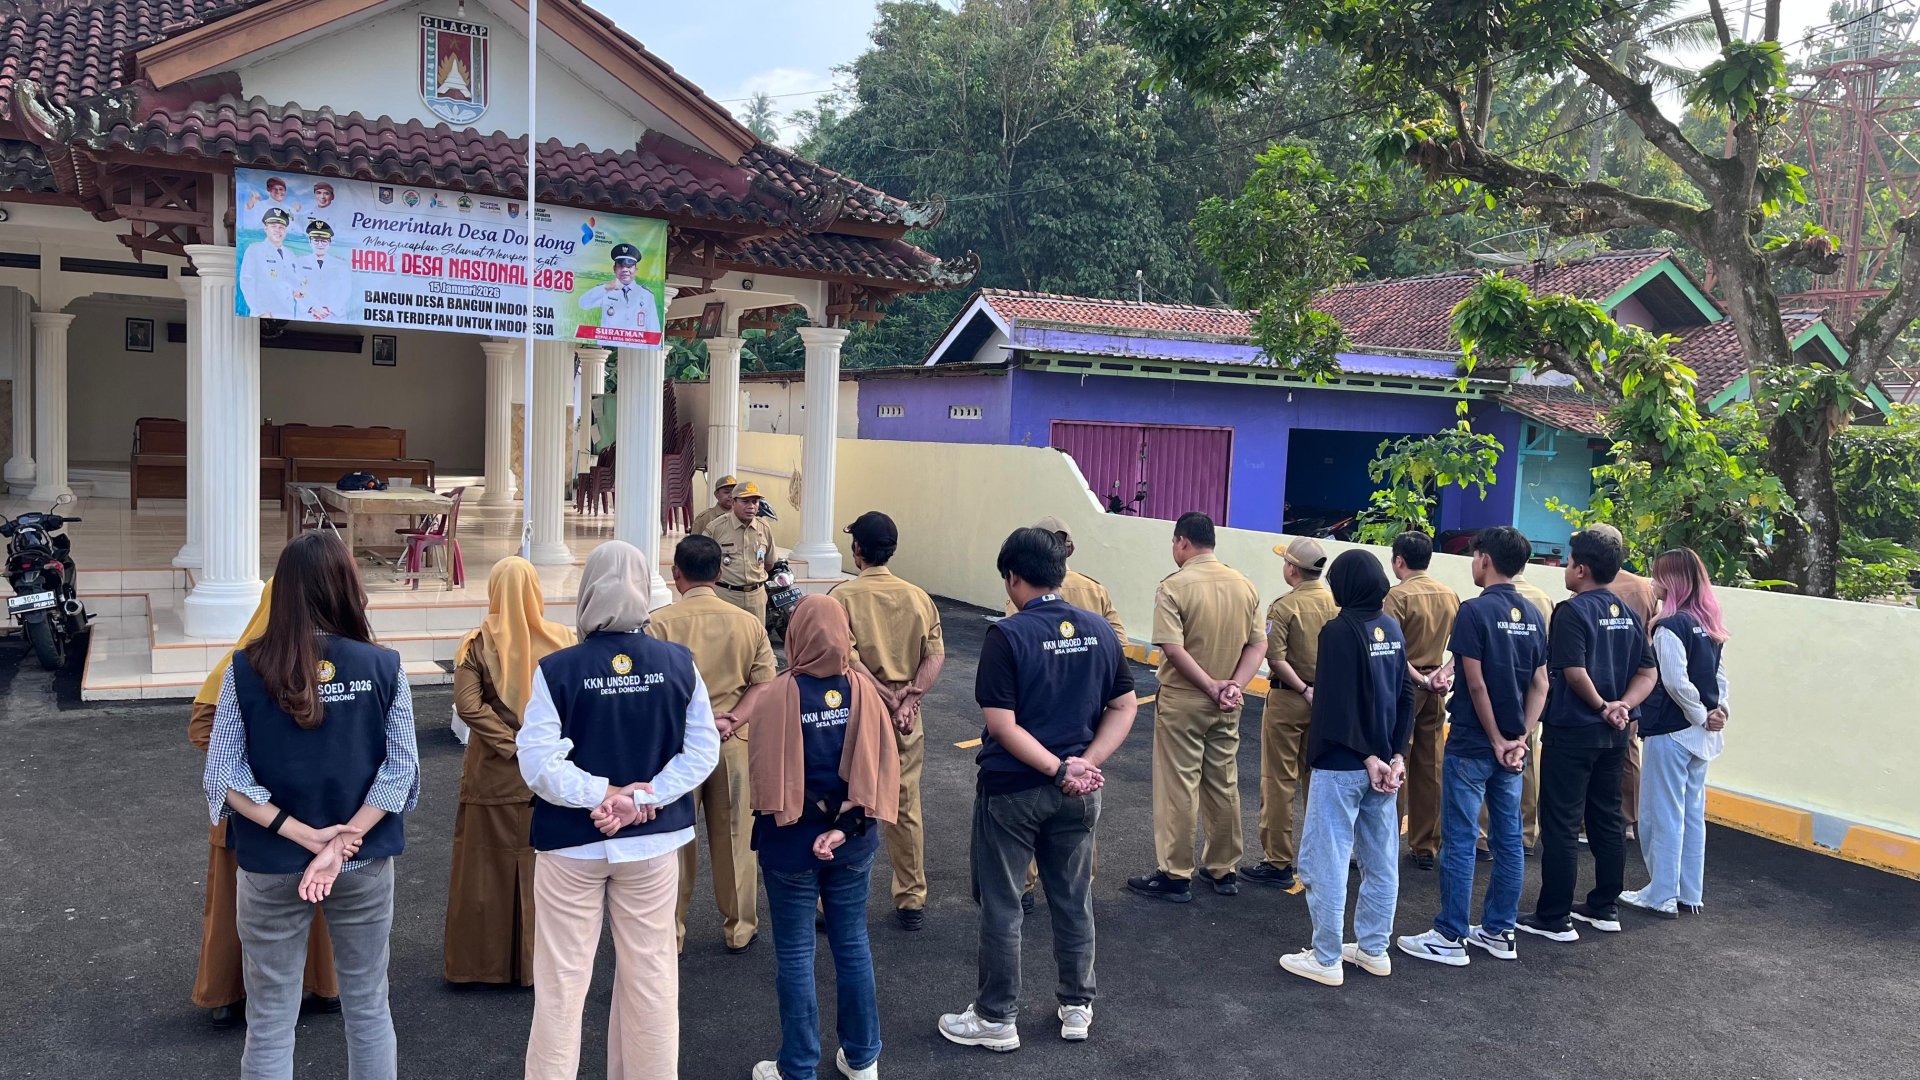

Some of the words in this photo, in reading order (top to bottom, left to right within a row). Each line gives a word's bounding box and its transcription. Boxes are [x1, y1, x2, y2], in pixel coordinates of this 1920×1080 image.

[424, 18, 486, 36] CILACAP
[351, 212, 453, 237] Pemerintah
[458, 223, 498, 242] Desa
[363, 236, 439, 255] Mengucapkan
[441, 243, 488, 258] Selamat
[486, 248, 562, 270] Mempergati
[351, 249, 396, 273] HARI
[401, 253, 443, 277] DESA
[448, 257, 528, 286] NASIONAL
[534, 268, 575, 292] 2026
[429, 281, 441, 293] 15
[441, 282, 477, 296] Januari
[477, 286, 500, 298] 2026
[364, 290, 413, 306] BANGUN
[415, 294, 444, 309] DESA
[447, 297, 493, 313] BANGUN
[363, 308, 395, 322] DESA
[397, 310, 453, 327] TERDEPAN
[456, 315, 492, 330] UNTUK
[595, 327, 645, 339] SURATMAN
[1043, 640, 1056, 650] KKN
[1057, 637, 1082, 649] UNSOED
[317, 682, 345, 695] SOED
[349, 679, 372, 692] 2026
[584, 677, 604, 690] KKN
[606, 675, 640, 688] UNSOED
[644, 672, 665, 685] 2026
[319, 693, 356, 703] DONDONG
[600, 687, 617, 696] DESA
[618, 685, 650, 694] DONDONG
[801, 711, 818, 724] KKN
[820, 707, 849, 721] UNSOED
[815, 720, 831, 728] DESA
